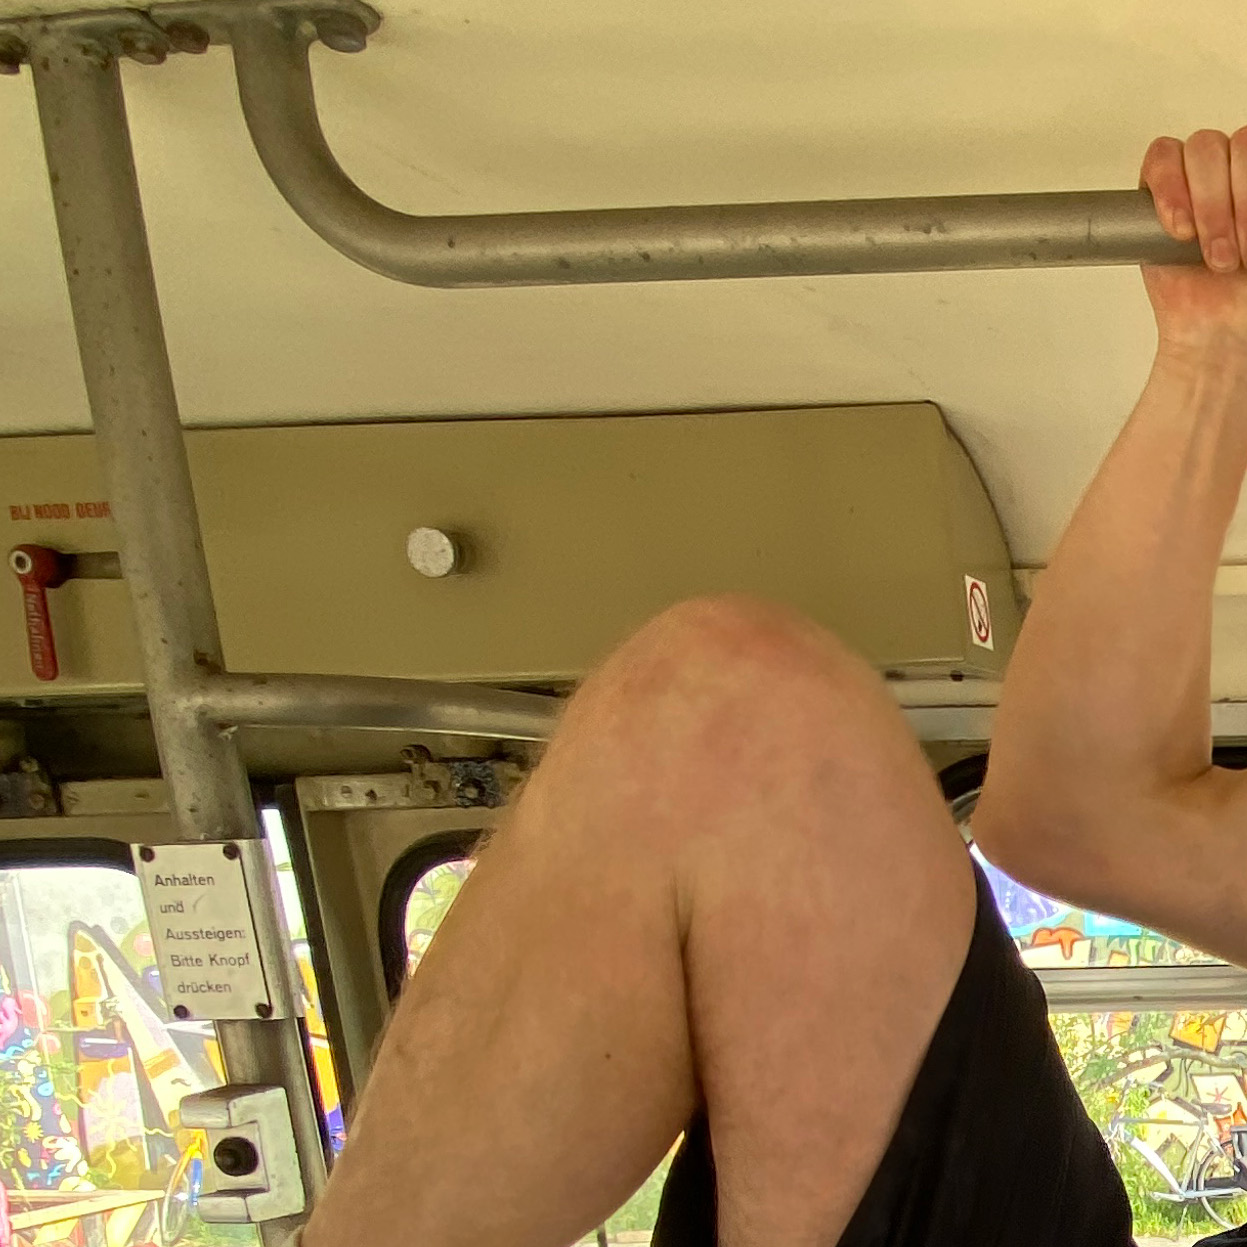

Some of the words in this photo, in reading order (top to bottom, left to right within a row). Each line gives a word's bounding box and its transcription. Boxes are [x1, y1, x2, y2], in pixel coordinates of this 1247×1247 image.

[154, 873, 215, 887] Anhalten
[160, 901, 185, 914] und
[166, 927, 246, 942] Aussteigen:
[171, 954, 203, 968] Bitte
[209, 953, 250, 968] Knopf
[177, 981, 232, 994] drücken
